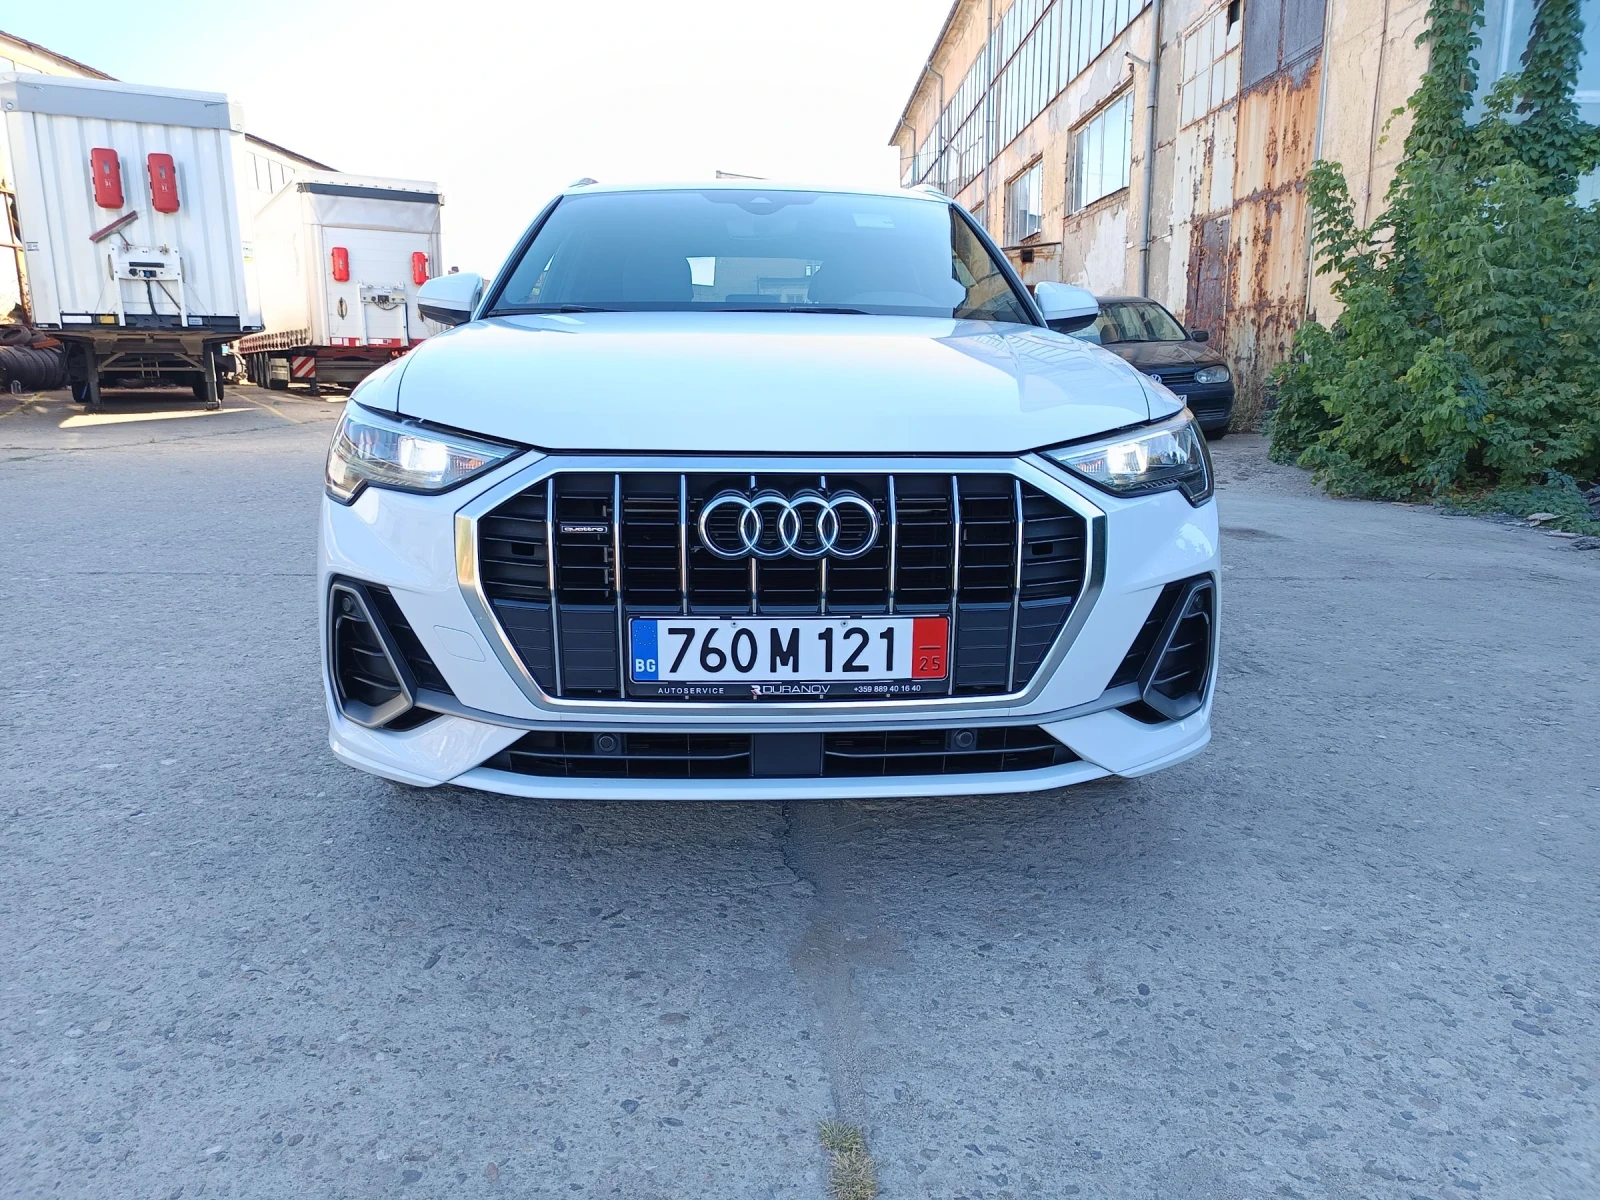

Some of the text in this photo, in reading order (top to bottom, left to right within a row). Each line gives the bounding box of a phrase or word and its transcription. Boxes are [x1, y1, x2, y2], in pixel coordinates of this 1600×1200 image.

[667, 627, 894, 673] 760 M 121
[634, 658, 656, 673] BG
[919, 655, 941, 671] 25
